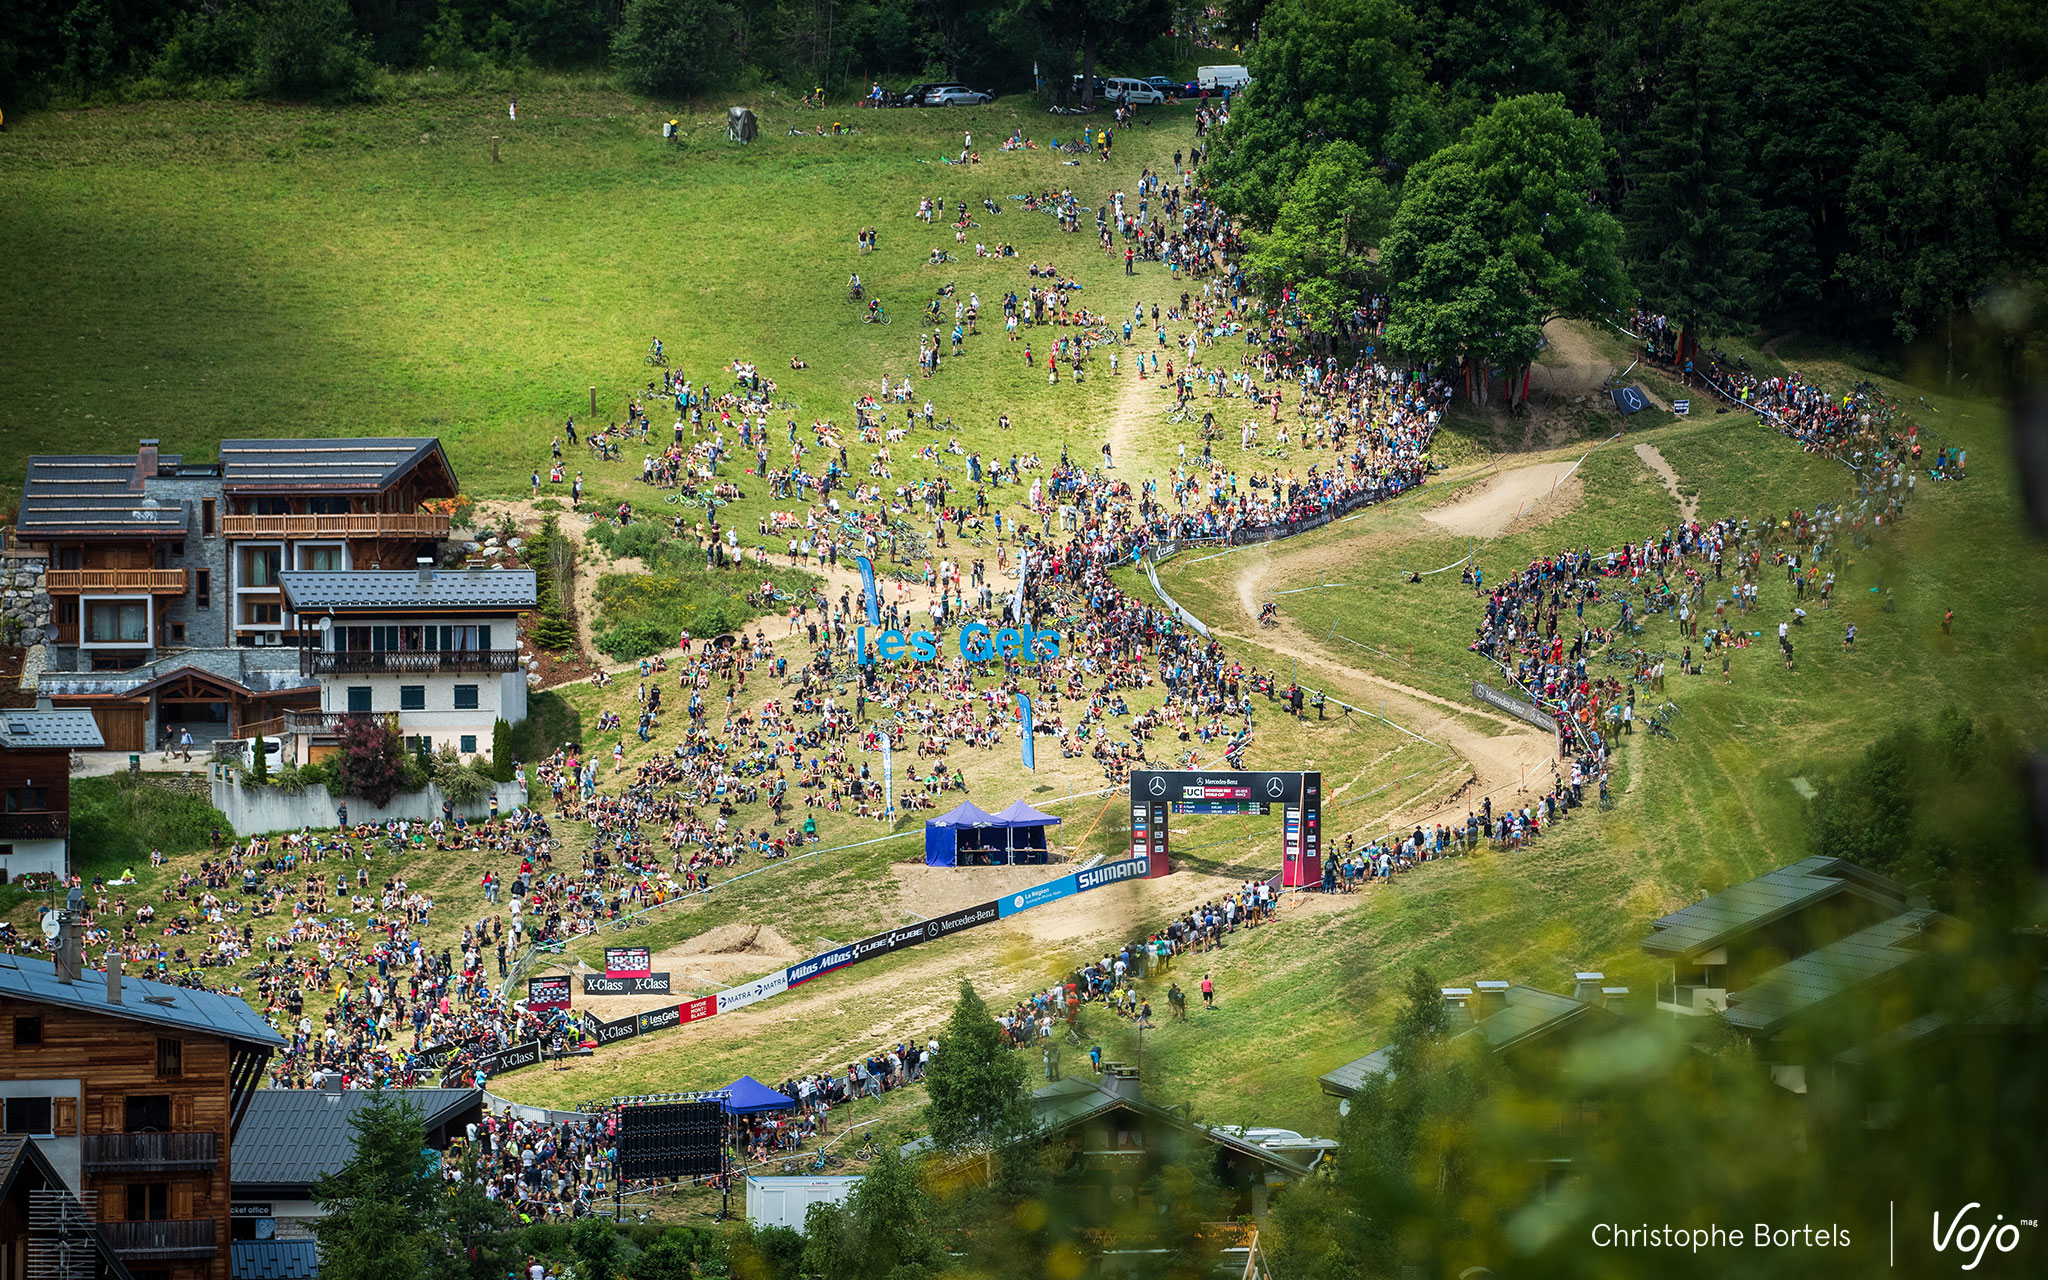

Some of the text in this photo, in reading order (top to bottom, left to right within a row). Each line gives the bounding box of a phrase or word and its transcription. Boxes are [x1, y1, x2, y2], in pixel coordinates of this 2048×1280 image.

[1160, 543, 1175, 556] CUBE
[960, 623, 1061, 662] Gets
[1485, 689, 1525, 714] Mercedes-Benz
[1186, 788, 1203, 797] UCI
[1078, 860, 1147, 889] SHIMANO
[941, 908, 995, 932] Mercedes-Benz
[896, 927, 924, 942] CUBE
[859, 939, 887, 954] CUBE
[819, 949, 851, 970] Mitas
[788, 961, 818, 982] Mitas
[587, 979, 623, 991] X-Class
[635, 978, 668, 990] X-Class
[763, 977, 786, 992] MATRA
[690, 1000, 707, 1009] SAVOIE
[727, 991, 752, 1004] MATRA
[650, 1015, 662, 1025] Les
[662, 1010, 679, 1021] Gets
[690, 1011, 707, 1019] BLANC
[600, 1024, 633, 1041] X-Class
[501, 1051, 534, 1069] X-Class
[248, 1206, 269, 1214] office
